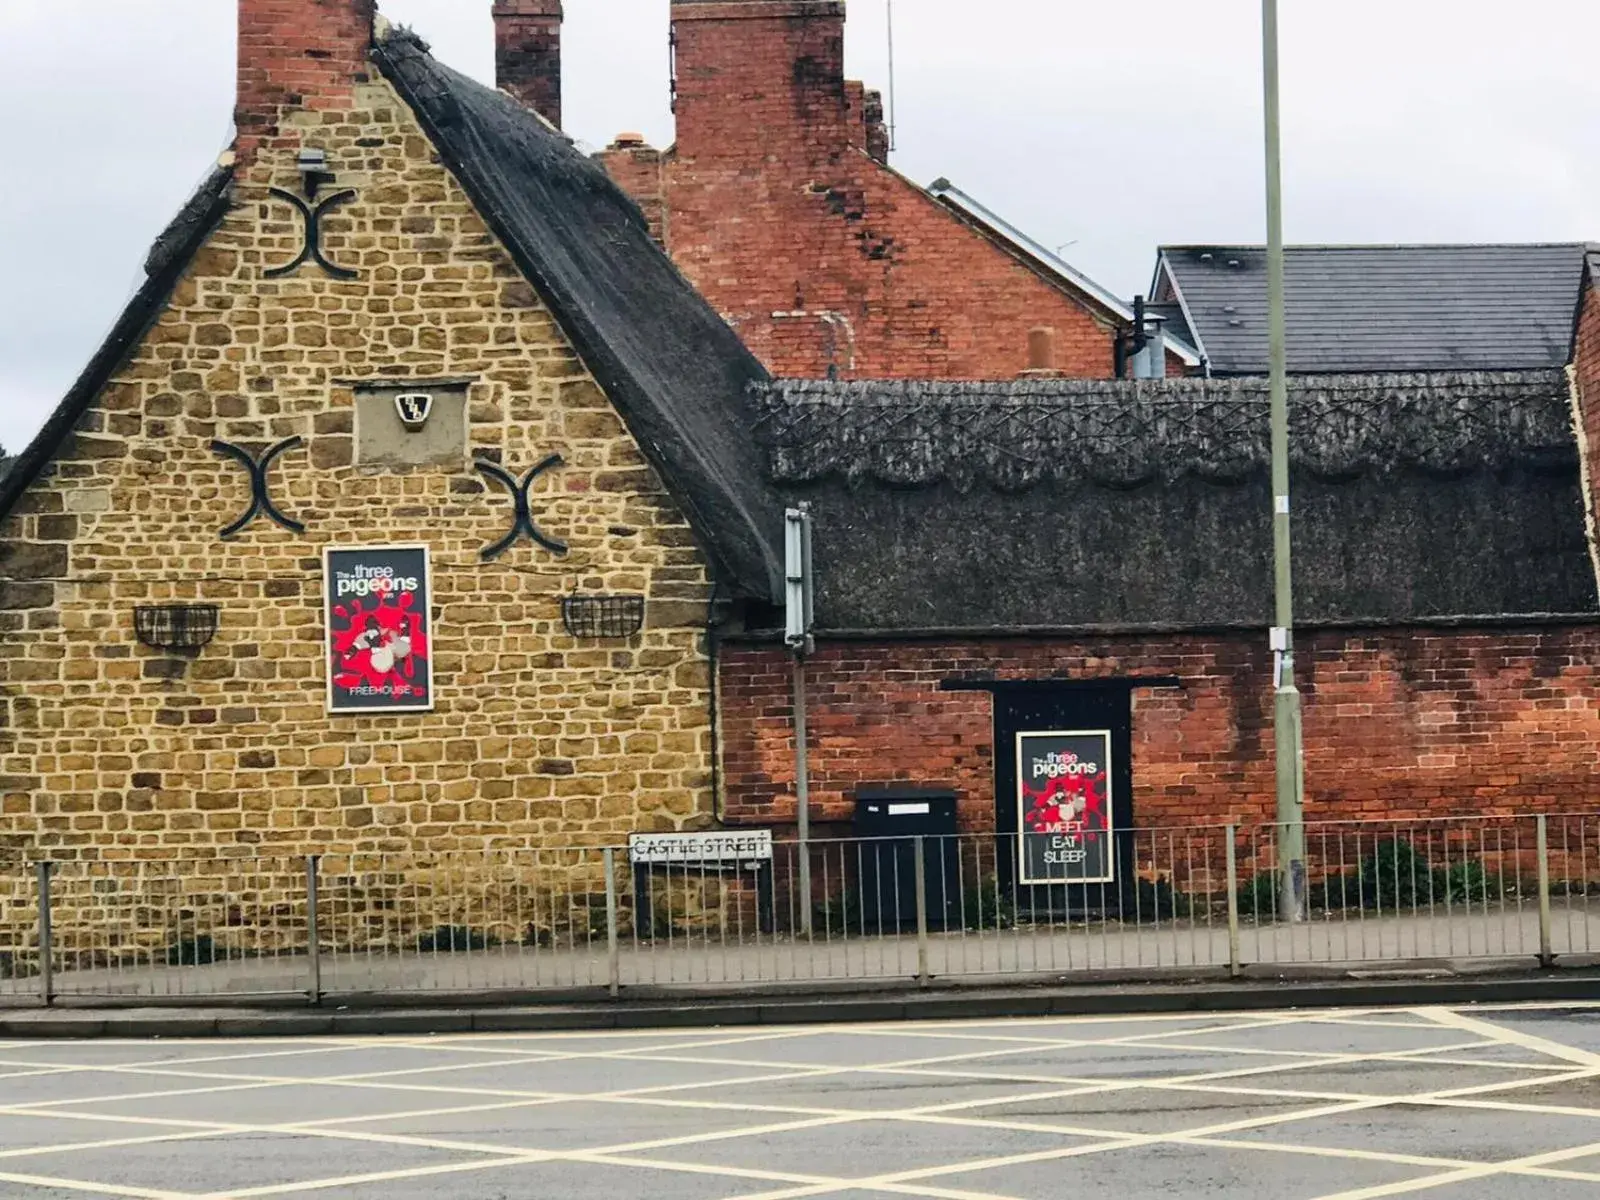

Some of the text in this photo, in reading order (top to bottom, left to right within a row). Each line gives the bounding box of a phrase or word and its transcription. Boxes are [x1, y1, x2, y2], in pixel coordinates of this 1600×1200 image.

[354, 564, 394, 578] three
[337, 575, 418, 597] pigeons
[349, 685, 412, 696] FREEHOUSE
[1047, 752, 1079, 764] three
[1032, 761, 1097, 778] pigeons
[1046, 821, 1083, 833] MEET
[634, 836, 768, 855] CASTLE STREET
[1052, 836, 1077, 849] EAT
[1043, 850, 1087, 863] SLEEP
